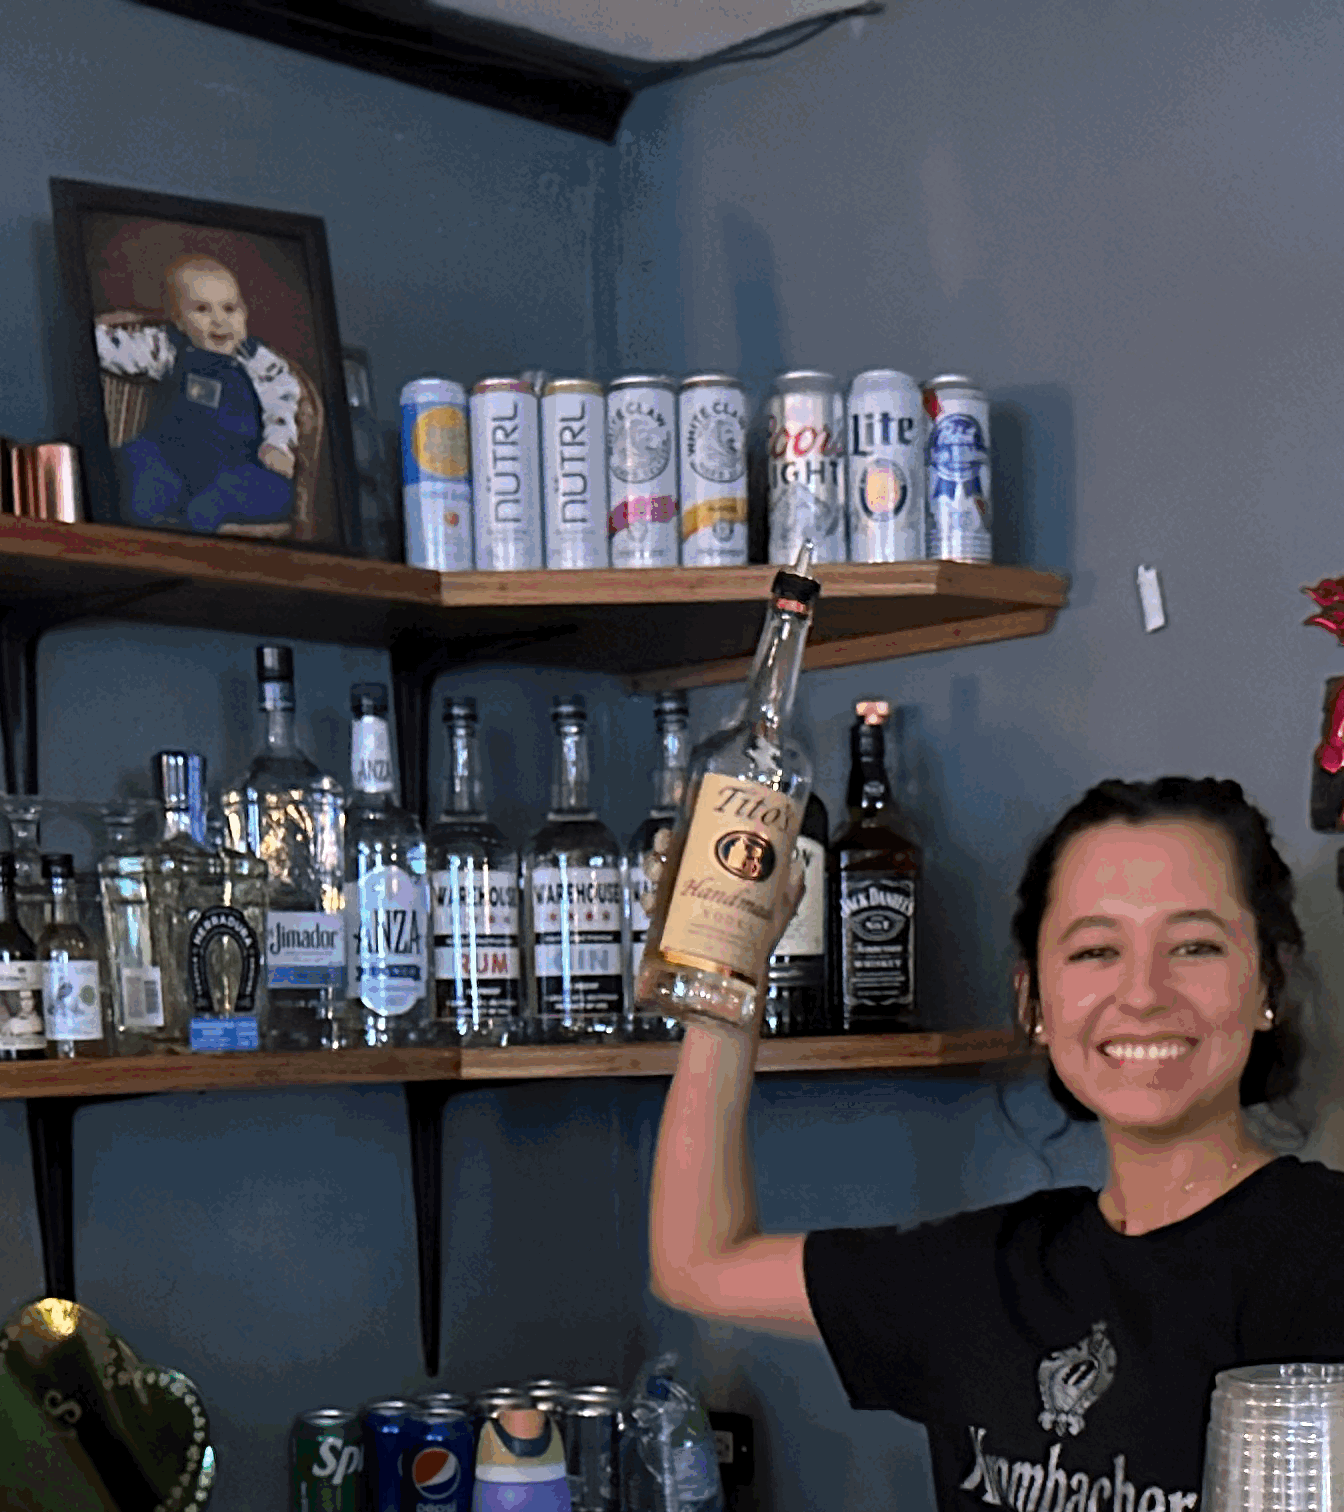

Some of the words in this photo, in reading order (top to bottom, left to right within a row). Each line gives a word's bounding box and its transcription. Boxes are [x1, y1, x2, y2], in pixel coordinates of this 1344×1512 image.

[852, 411, 915, 457] Lite
[713, 785, 792, 834] Tito's
[269, 921, 338, 955] Jimador
